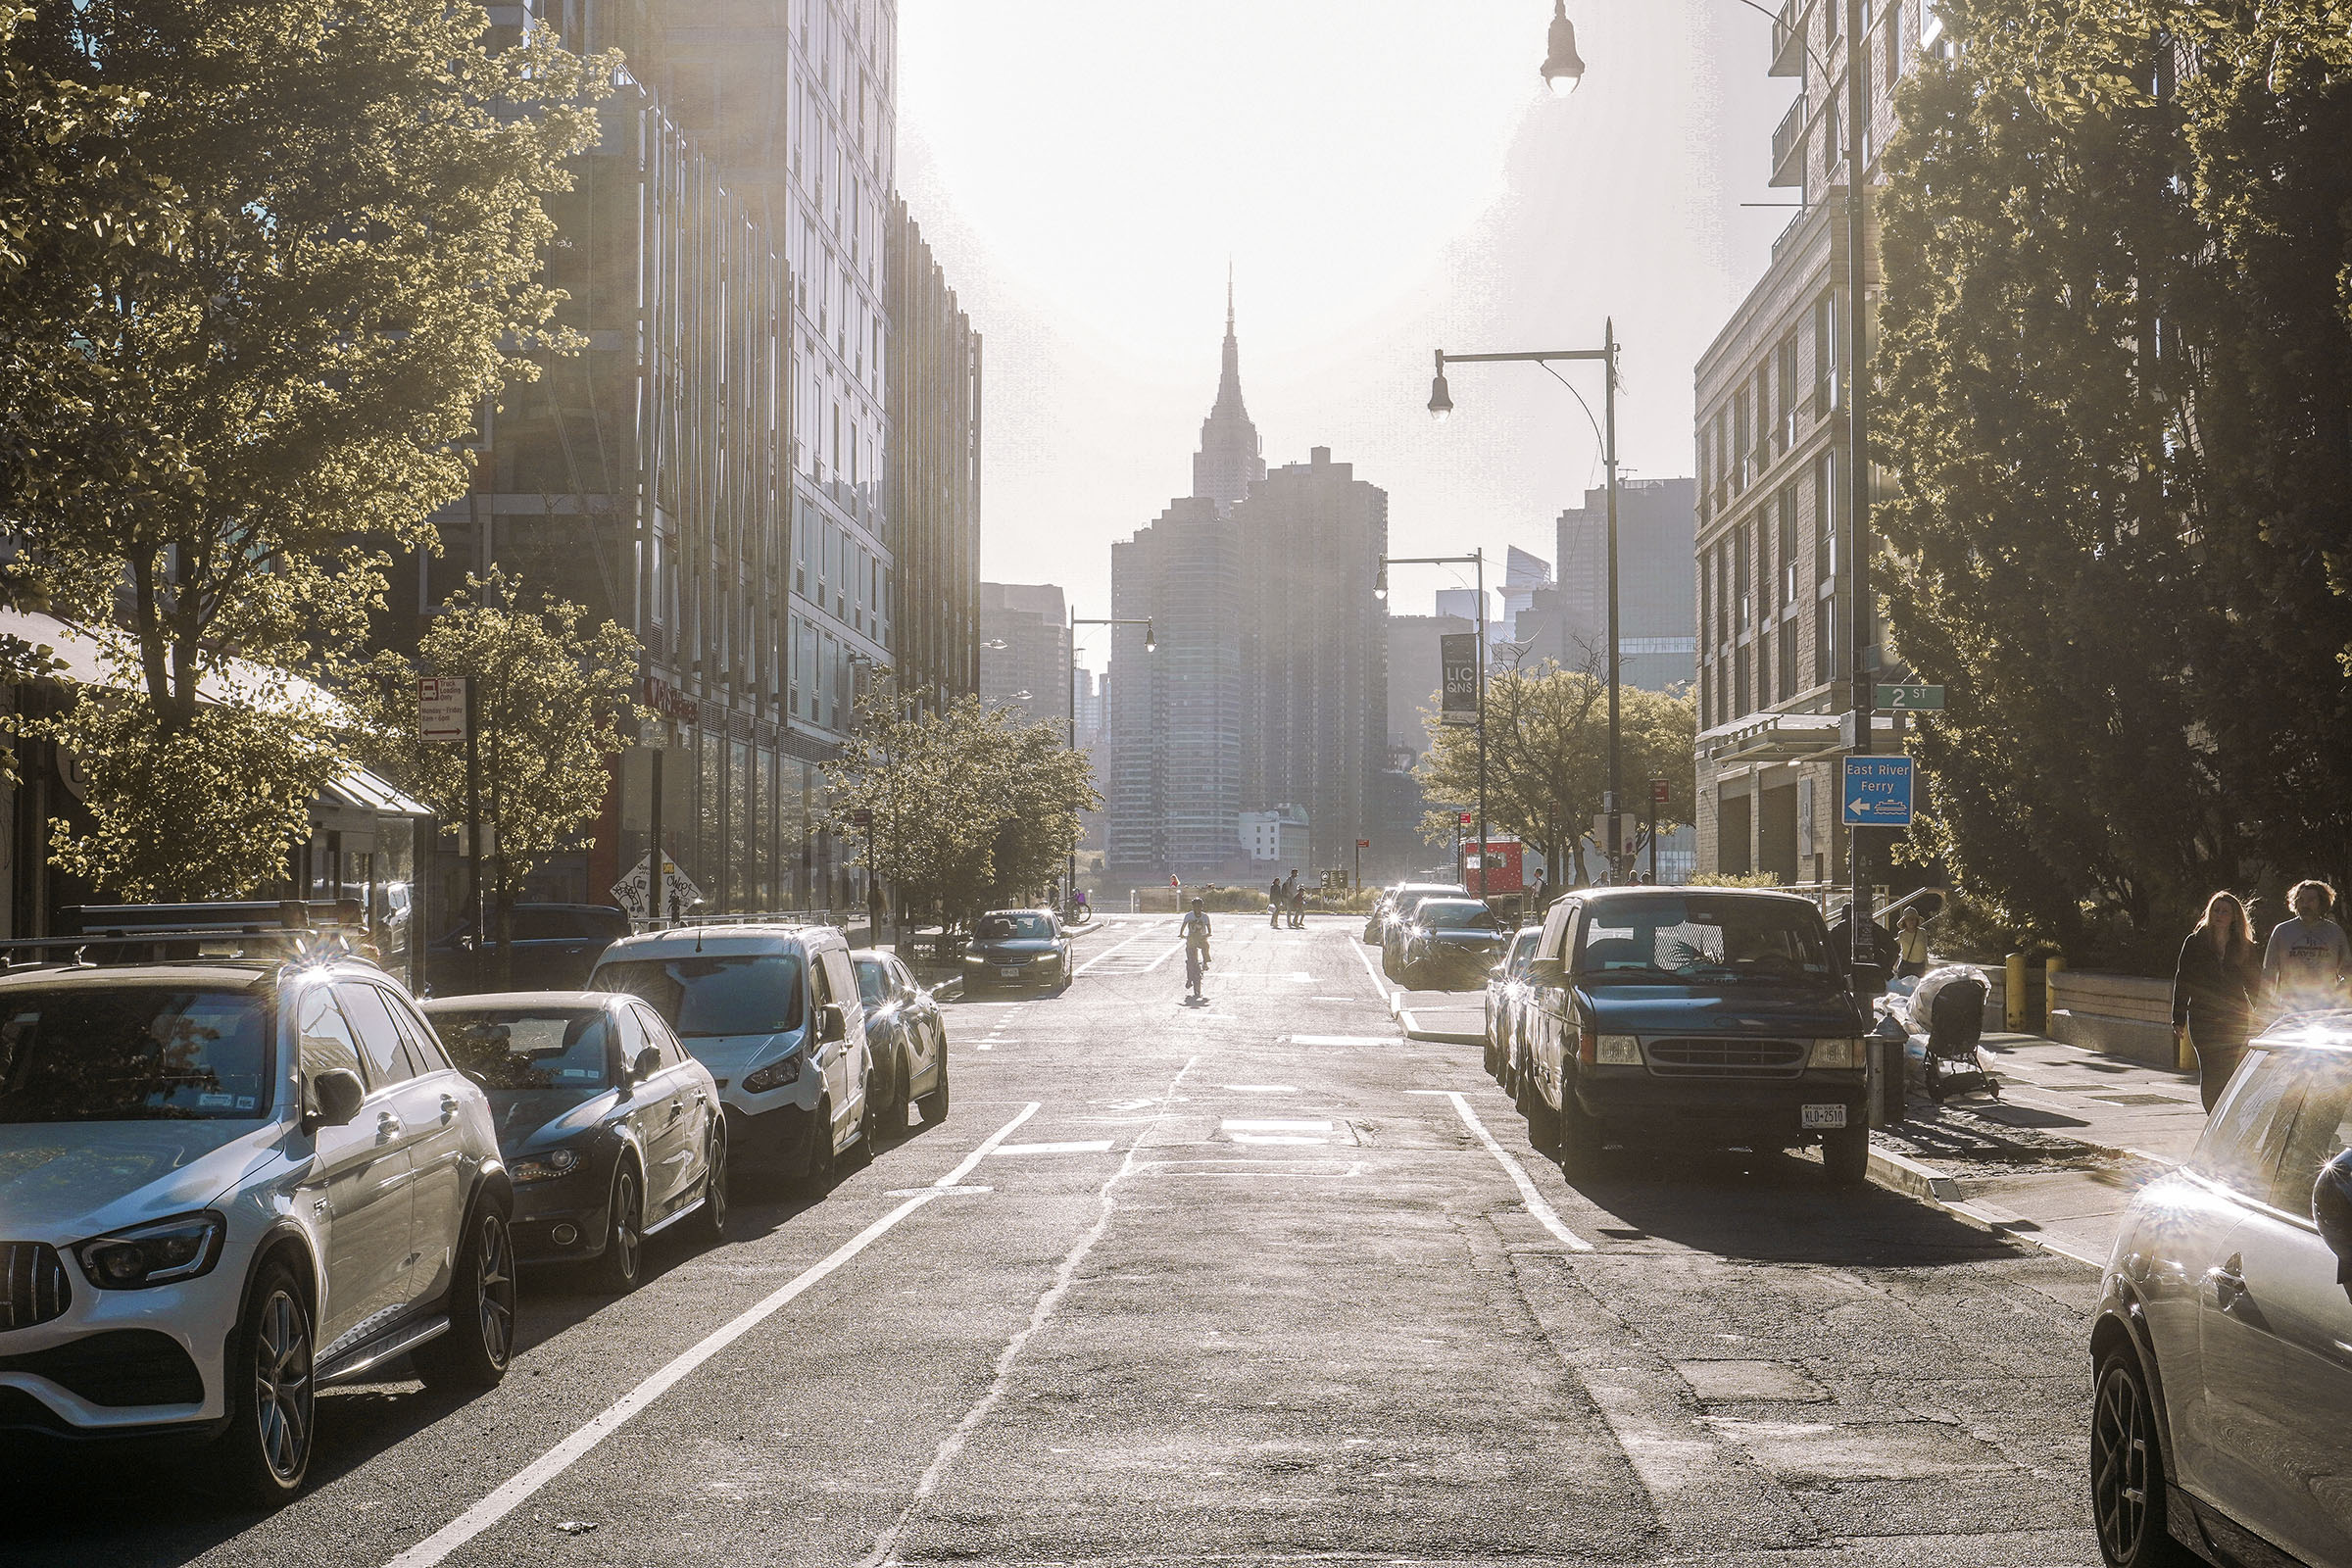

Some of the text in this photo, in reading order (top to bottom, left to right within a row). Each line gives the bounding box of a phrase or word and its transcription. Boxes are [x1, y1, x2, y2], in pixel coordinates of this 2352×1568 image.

[1446, 667, 1474, 681] LIC
[1446, 681, 1473, 693] QNS
[1891, 688, 1927, 707] 2 ST
[1846, 763, 1910, 775] East River
[1861, 781, 1895, 794] Ferry
